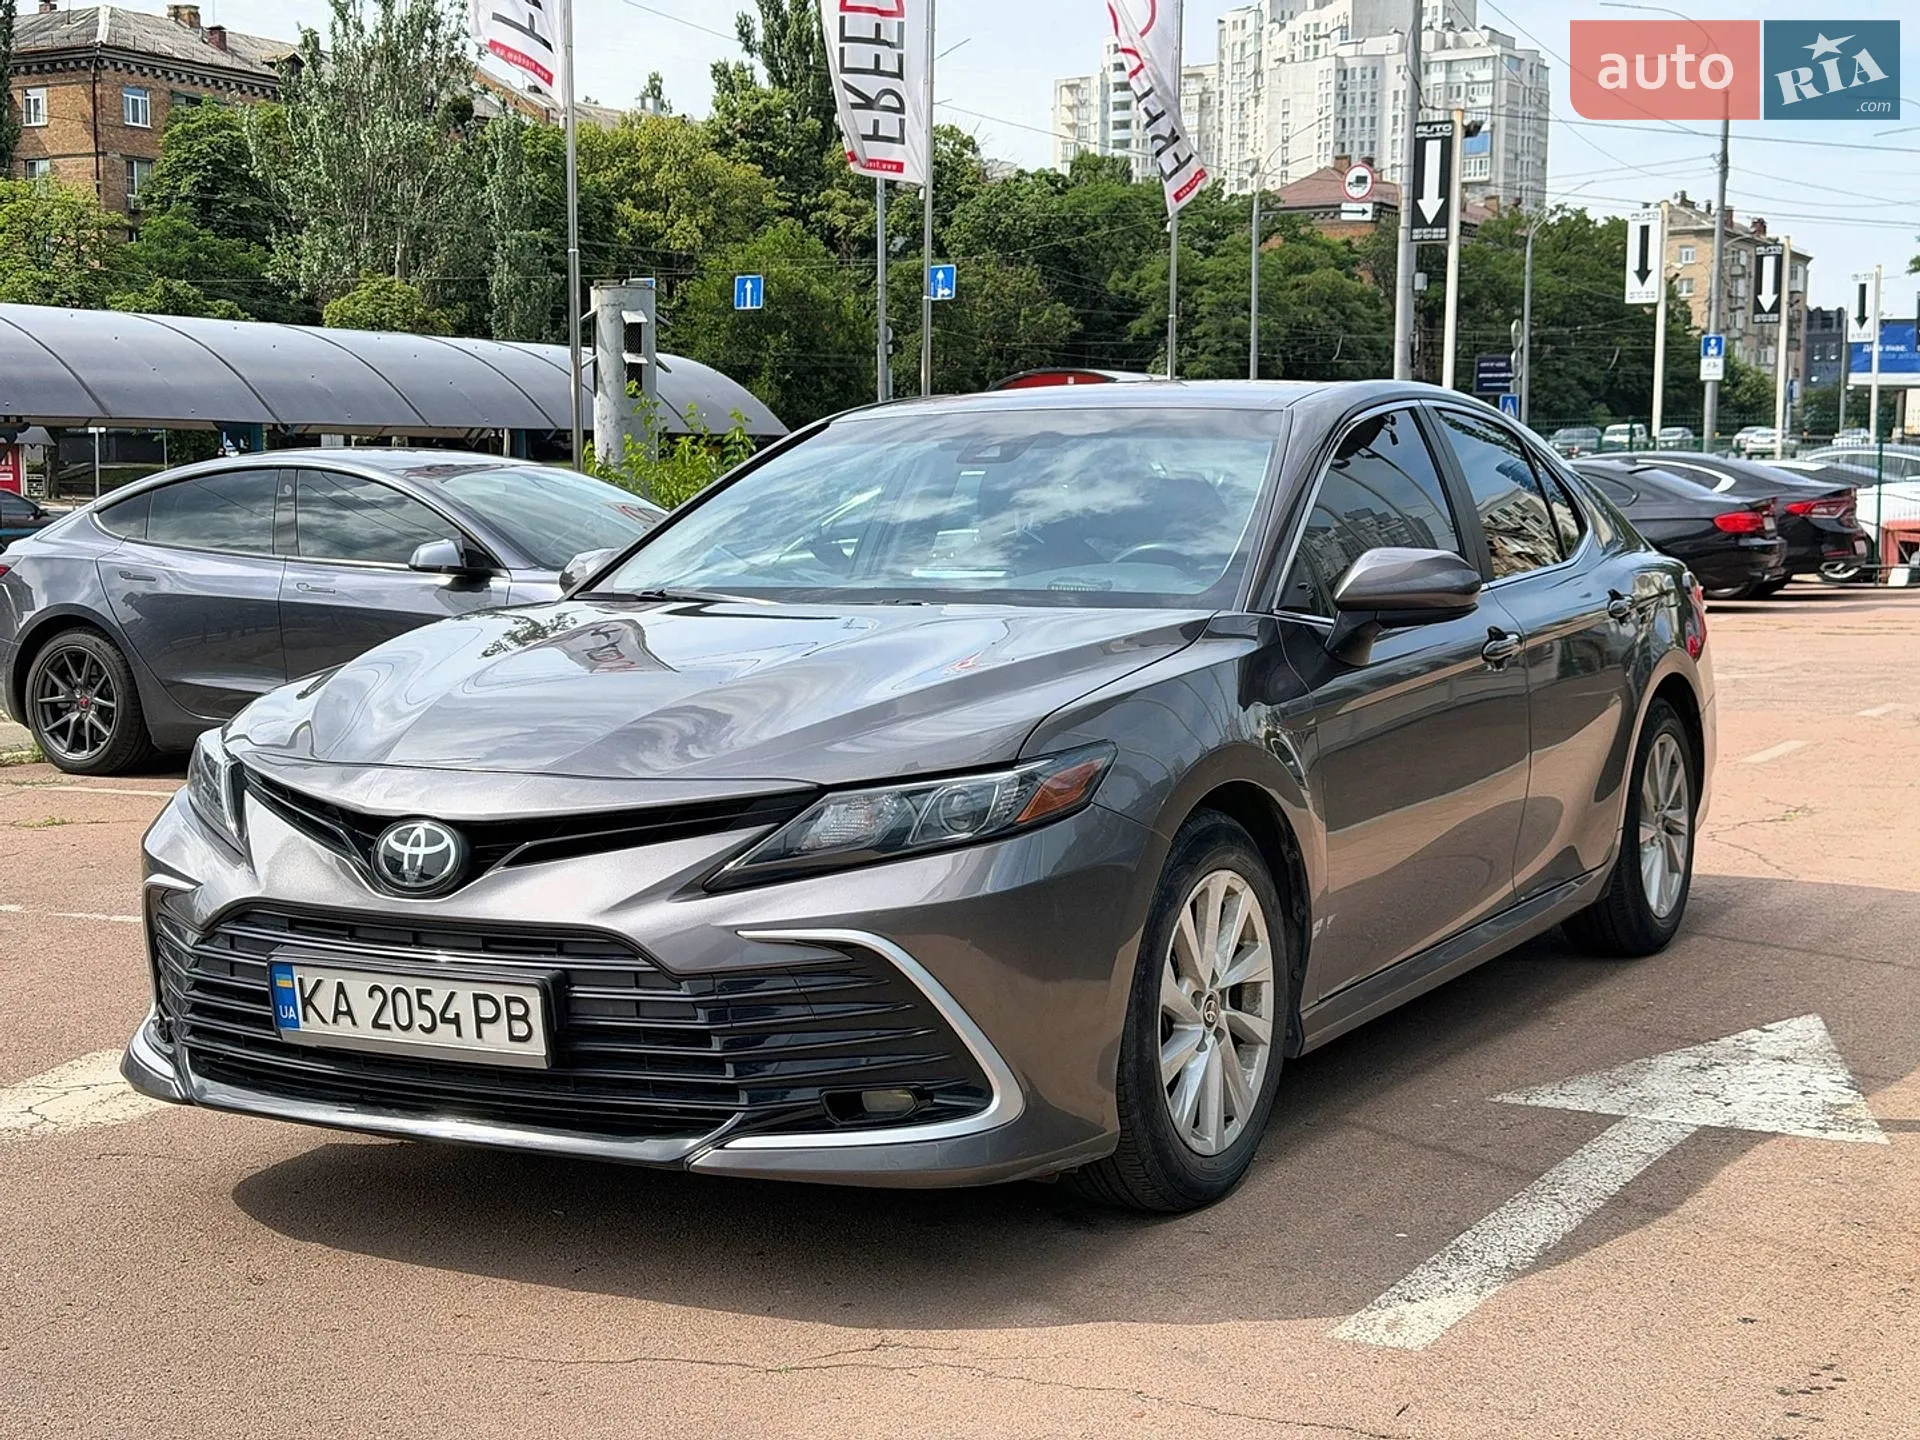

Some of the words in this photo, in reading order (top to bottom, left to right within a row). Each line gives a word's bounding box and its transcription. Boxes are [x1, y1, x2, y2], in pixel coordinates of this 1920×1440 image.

[1416, 123, 1453, 132] AUTO
[279, 1005, 298, 1021] UA
[296, 976, 358, 1028] KA
[367, 984, 463, 1038] 2054
[471, 992, 534, 1043] PB
